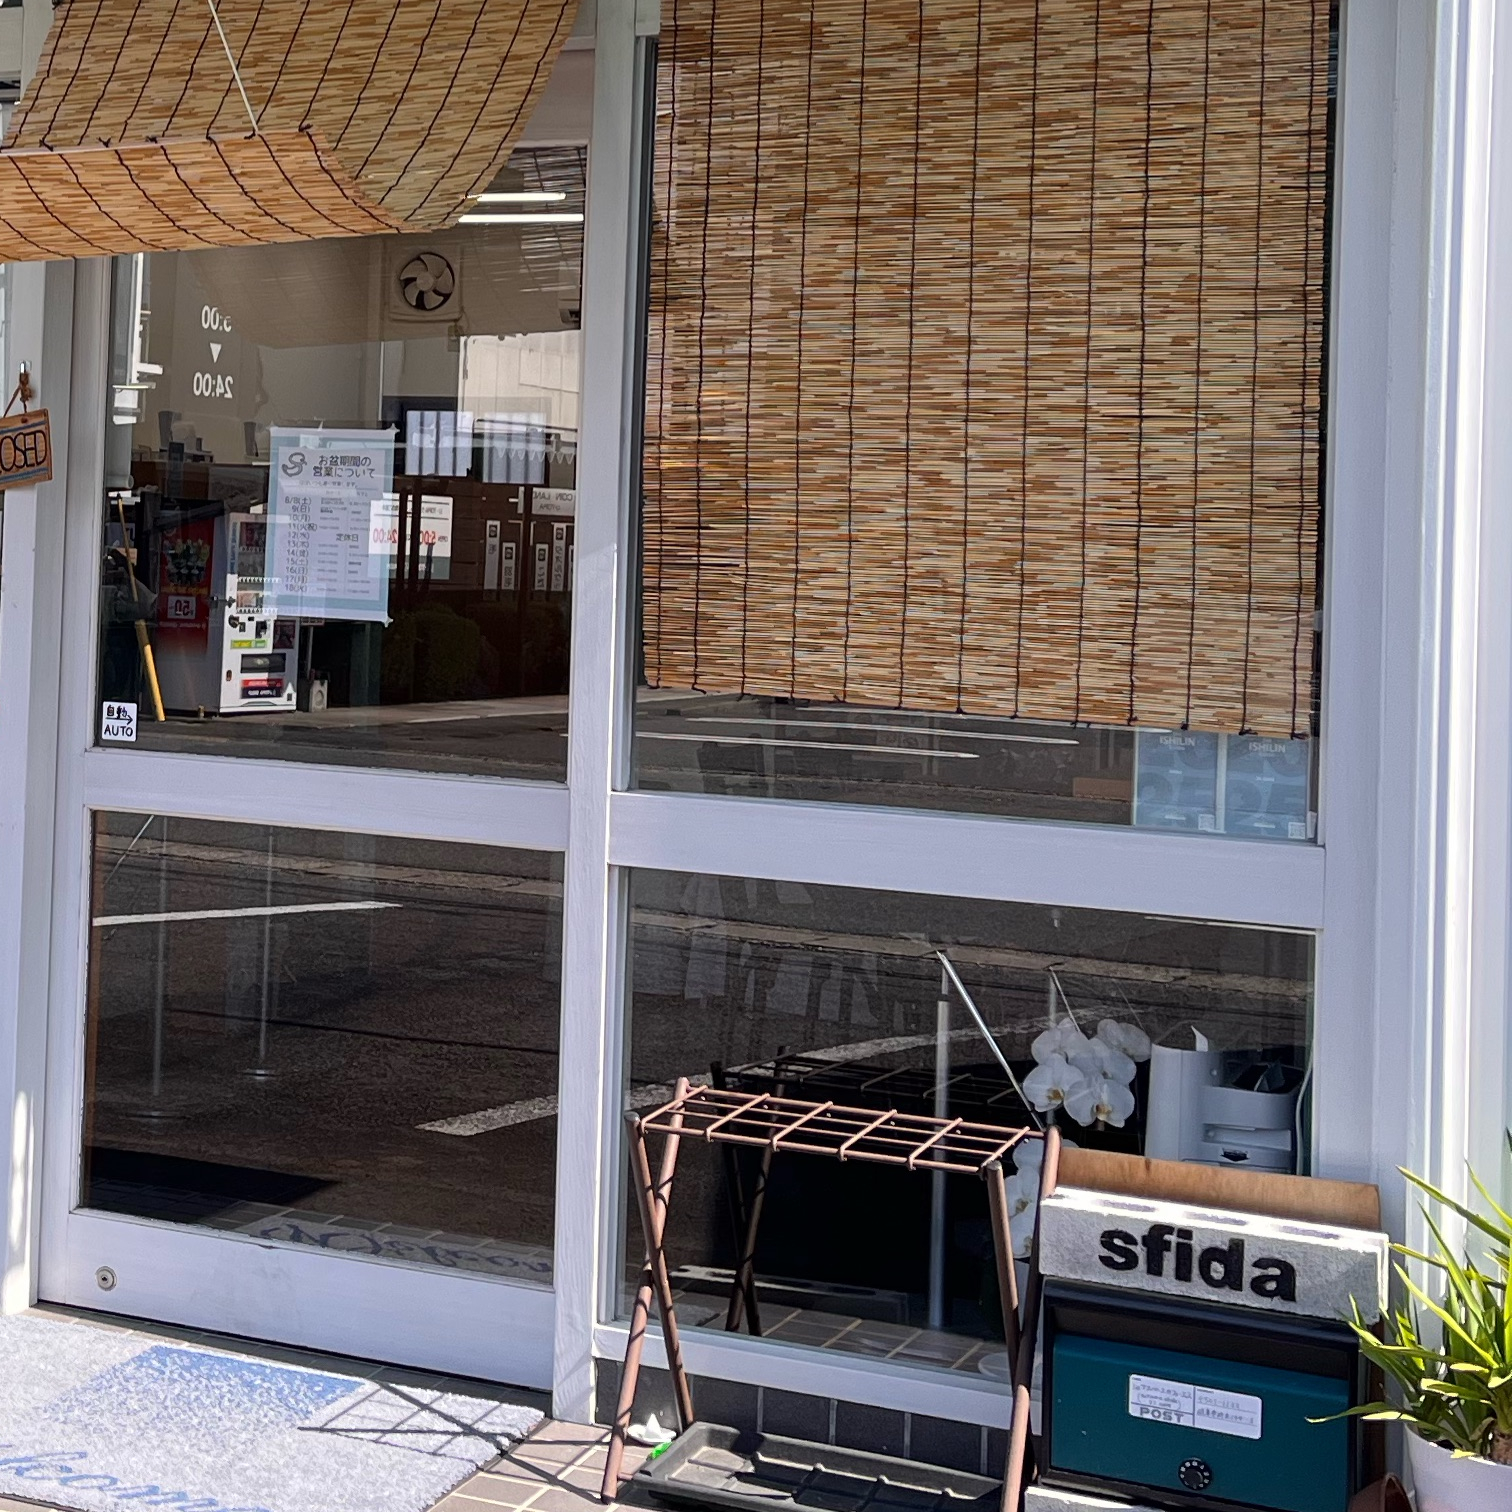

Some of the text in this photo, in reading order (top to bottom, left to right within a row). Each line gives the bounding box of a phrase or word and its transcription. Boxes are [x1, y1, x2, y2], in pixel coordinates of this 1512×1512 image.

[318, 454, 372, 467] お盆期間の
[312, 466, 376, 479] 営業について
[335, 533, 359, 542] 定休日
[104, 724, 134, 737] AUTO
[1098, 1223, 1297, 1302] sfida
[1139, 1407, 1185, 1423] POST
